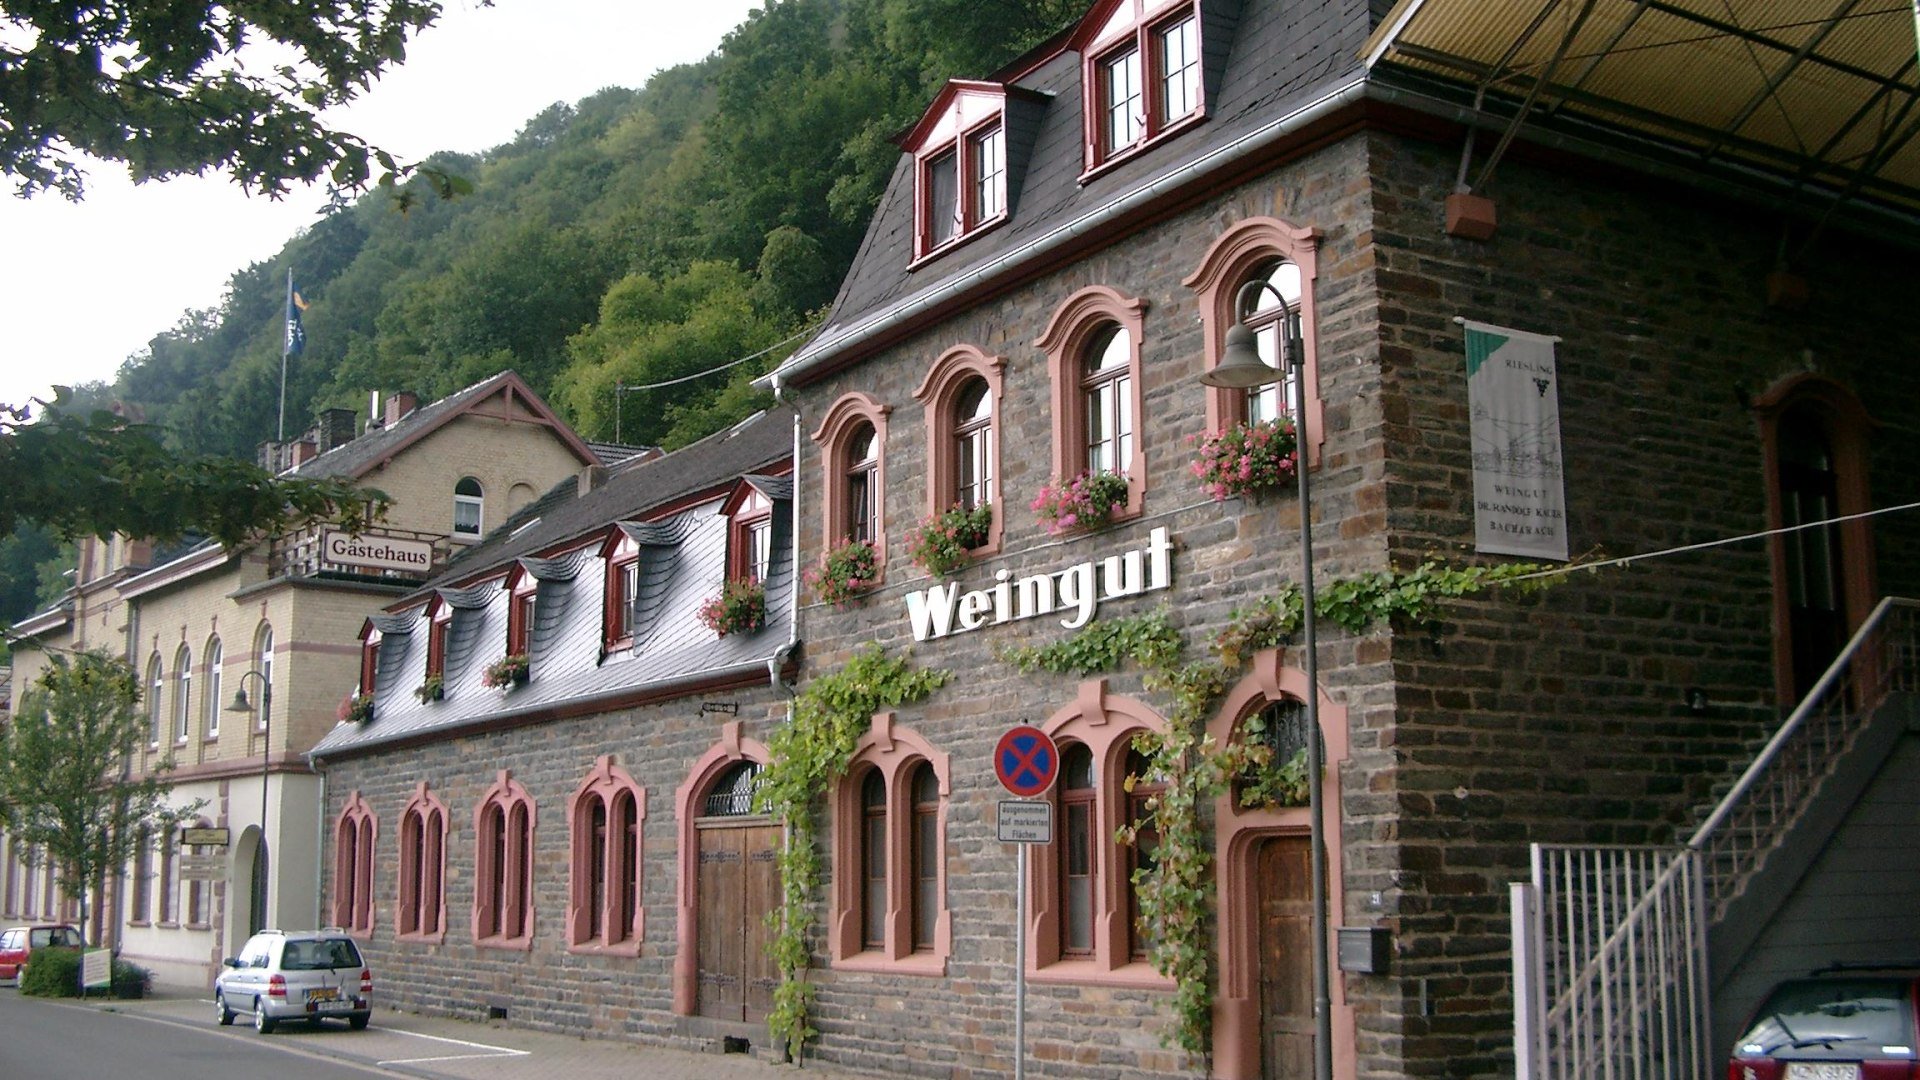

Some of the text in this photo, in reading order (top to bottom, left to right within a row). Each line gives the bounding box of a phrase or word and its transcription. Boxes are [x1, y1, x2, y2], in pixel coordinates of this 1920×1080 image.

[1504, 359, 1553, 375] RIESLING
[1494, 484, 1547, 499] WEINGUT
[1489, 521, 1554, 536] BACHARACH
[332, 539, 427, 564] Gästehaus
[904, 526, 1174, 642] Weingut
[1002, 806, 1047, 815] ausgenommen
[1001, 817, 1048, 826] auf markierten
[1012, 830, 1037, 839] Flächen
